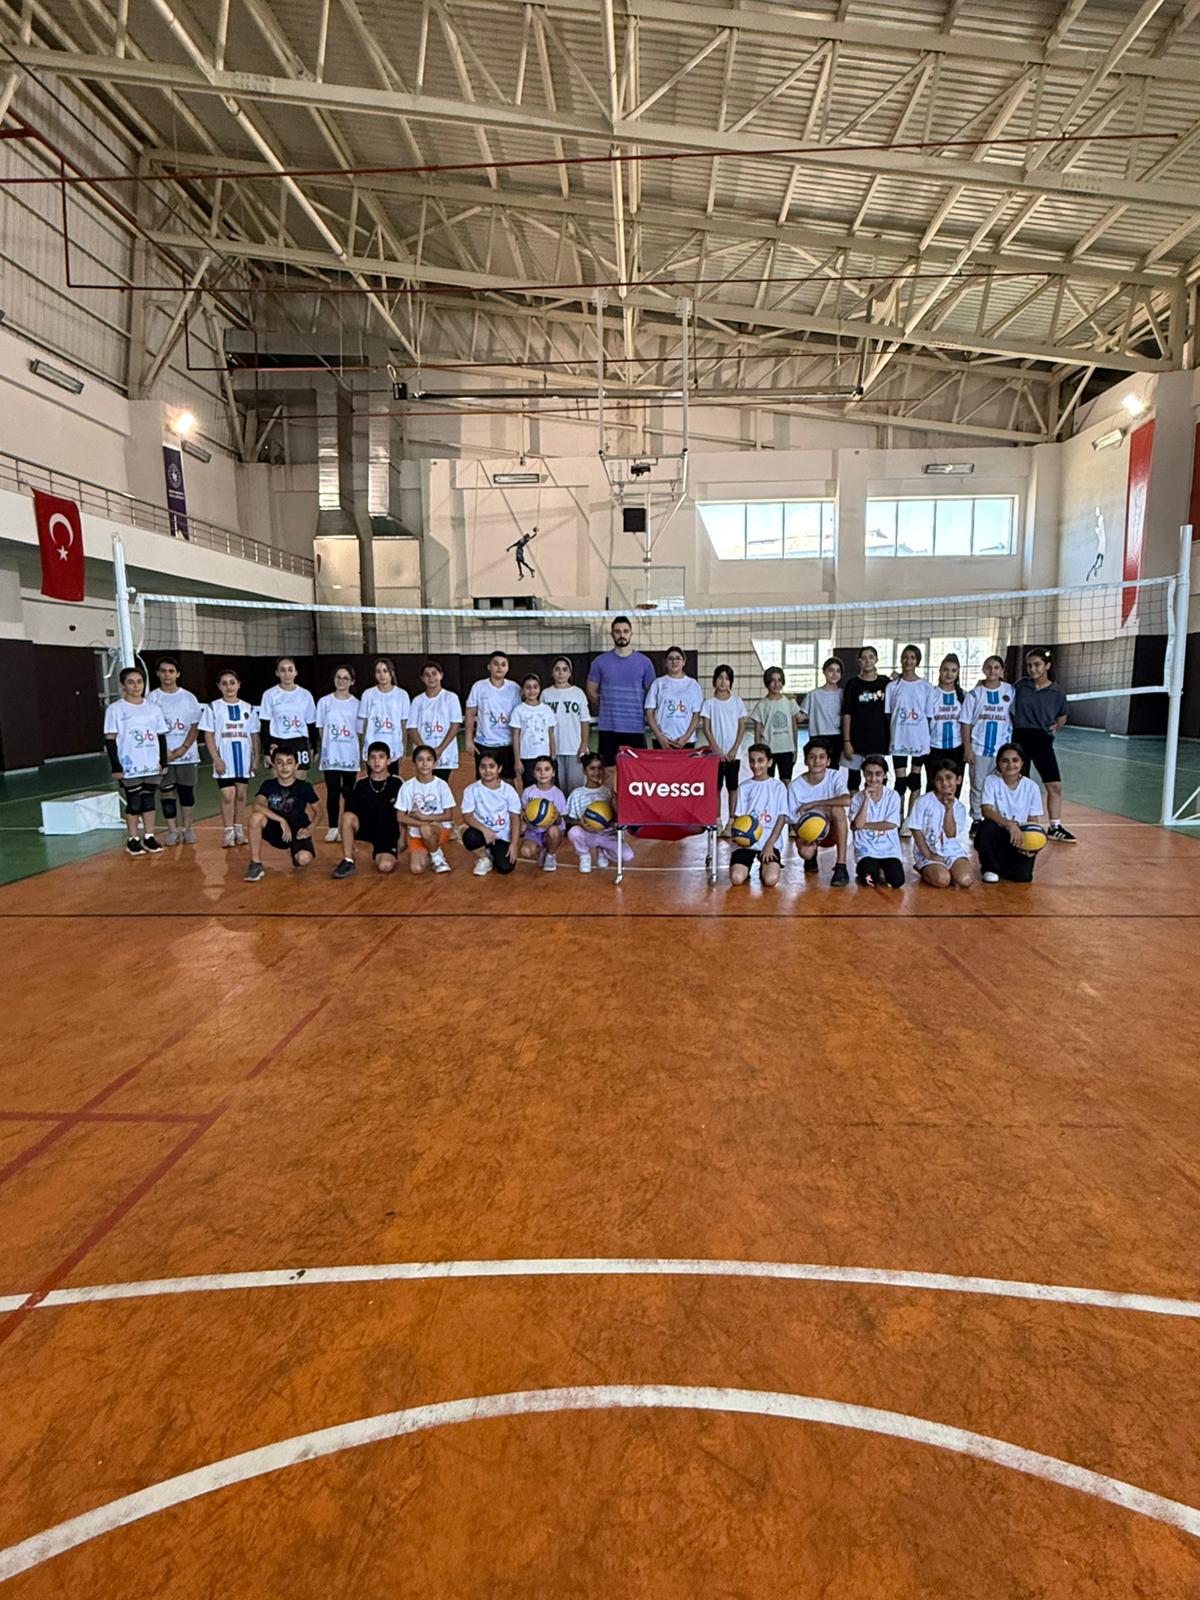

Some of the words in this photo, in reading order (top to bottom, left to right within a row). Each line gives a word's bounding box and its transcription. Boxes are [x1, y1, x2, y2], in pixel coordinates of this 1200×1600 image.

[563, 701, 581, 715] YO
[297, 750, 309, 765] 18
[628, 781, 705, 797] avessa
